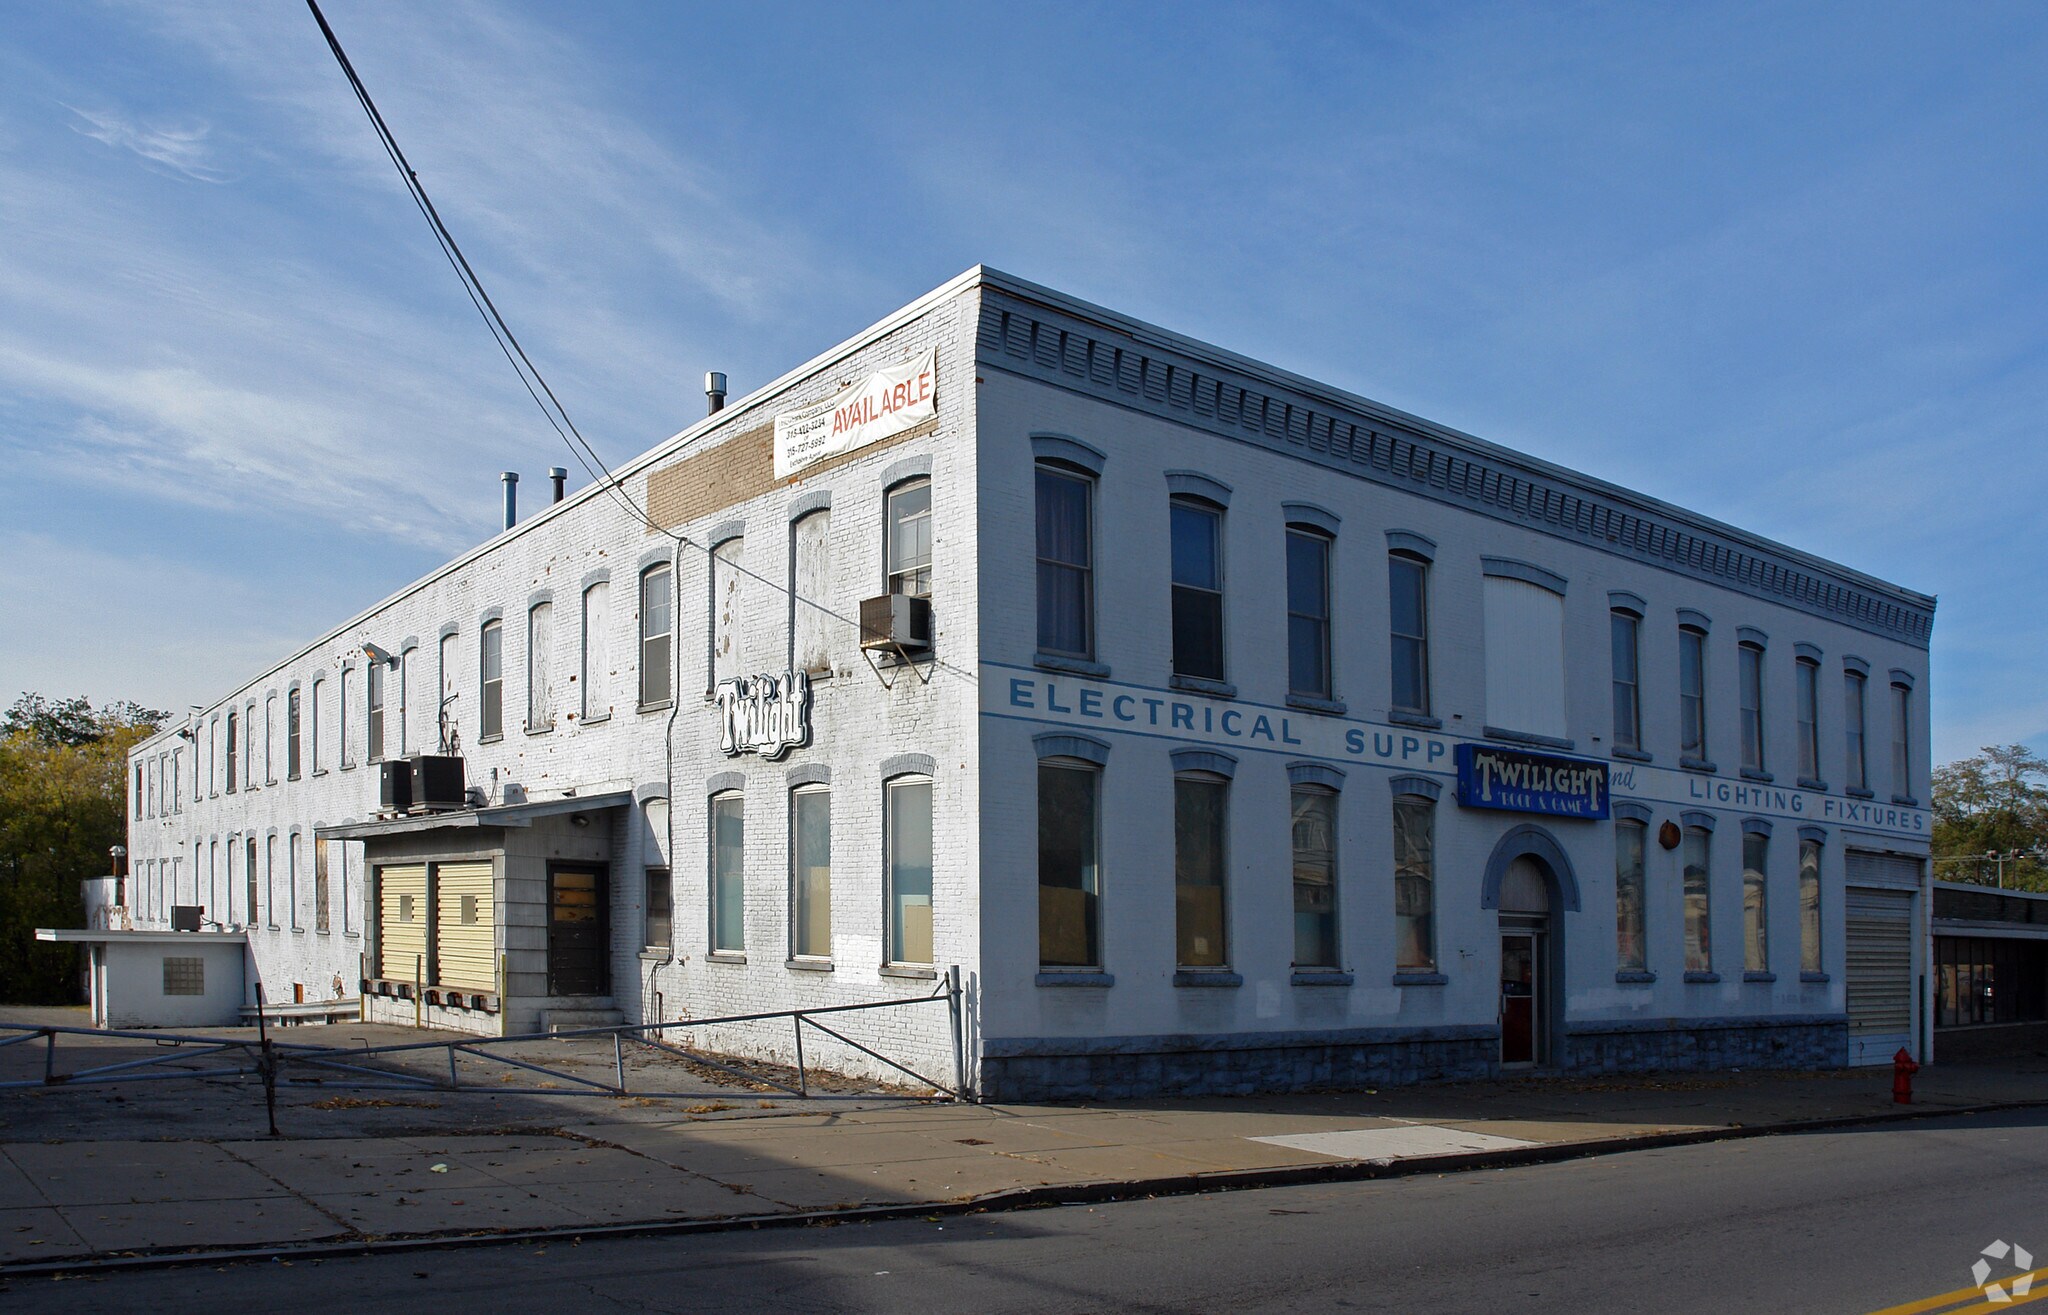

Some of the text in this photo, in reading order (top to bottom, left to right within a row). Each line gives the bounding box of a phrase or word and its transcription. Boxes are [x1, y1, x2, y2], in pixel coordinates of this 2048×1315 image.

[831, 371, 930, 437] AVAILABLE
[715, 670, 806, 759] Twilight
[1009, 677, 1301, 746] ELECTRICAL
[1608, 766, 1637, 790] nd
[1690, 778, 1803, 813] LIGHTING
[1824, 800, 1923, 830] FIXTURES
[1475, 752, 1603, 811] TWILIGHT
[1539, 795, 1547, 809] &
[1552, 797, 1583, 814] GAME
